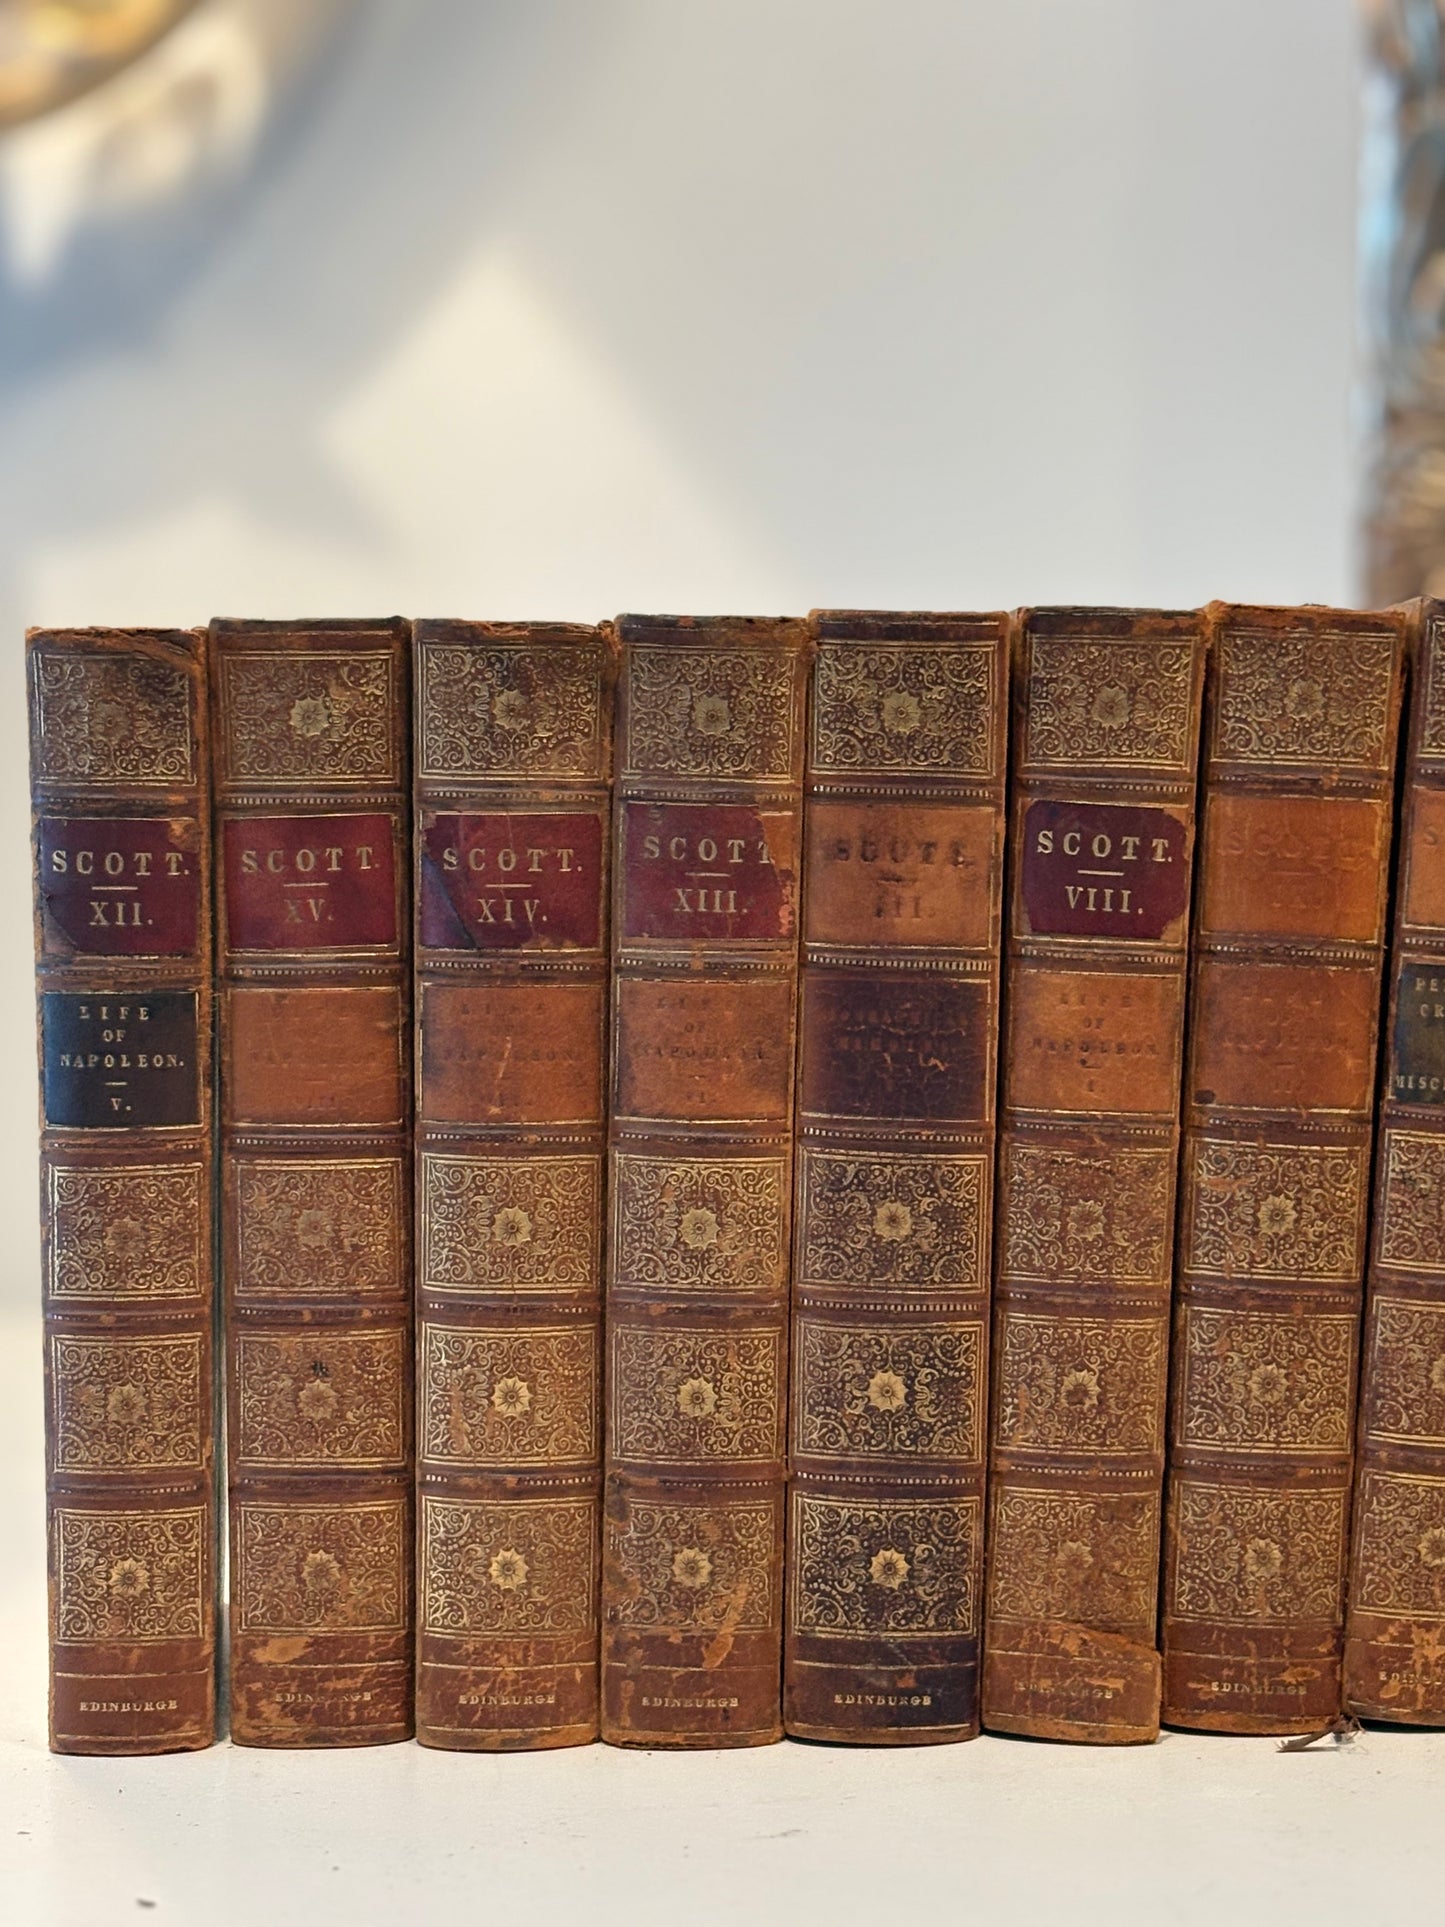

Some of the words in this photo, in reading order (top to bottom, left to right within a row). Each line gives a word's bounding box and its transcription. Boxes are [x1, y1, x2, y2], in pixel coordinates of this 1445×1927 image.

[1037, 831, 1173, 862] SCOTT.
[52, 850, 190, 876] SCOTT.
[241, 847, 381, 873] SCOTT.
[442, 847, 583, 873] SCOTT.
[284, 898, 336, 923] XV.
[477, 899, 548, 923] XIV.
[674, 887, 748, 914] XIII.
[1065, 886, 1144, 915] VIII.
[89, 901, 154, 926] XII.
[79, 1005, 150, 1021] LIFE
[102, 1029, 126, 1043] OF
[60, 1053, 185, 1069] NAPOLEON.
[110, 1097, 133, 1112] V.
